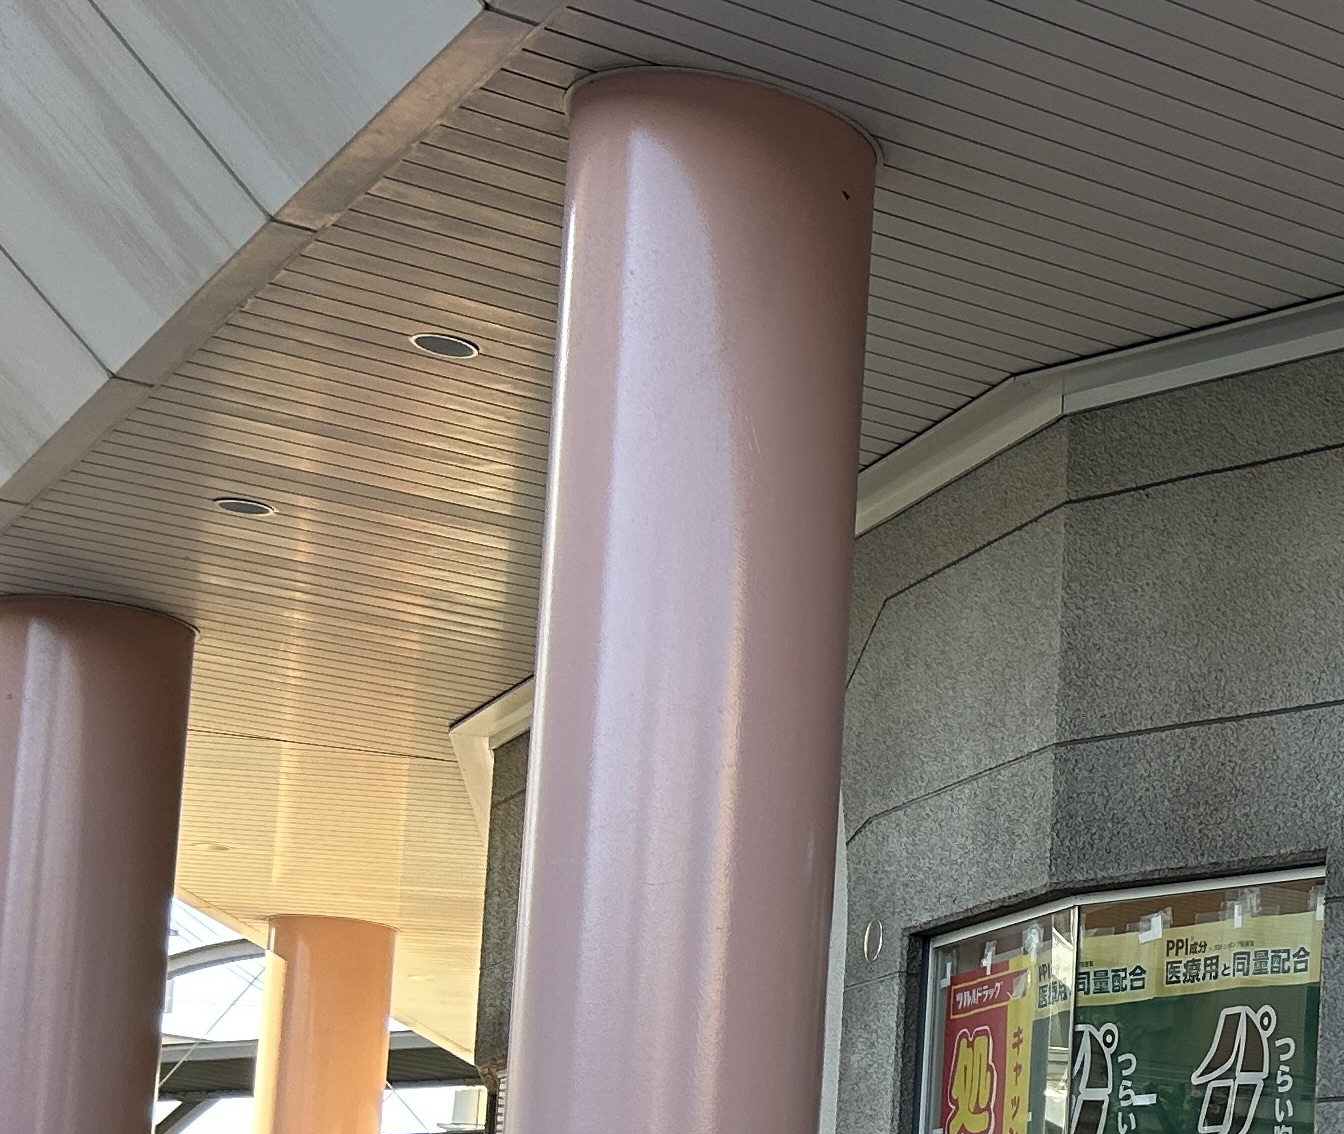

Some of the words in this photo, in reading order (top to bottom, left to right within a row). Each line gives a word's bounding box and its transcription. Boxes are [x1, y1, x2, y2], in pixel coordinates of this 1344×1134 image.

[1165, 947, 1312, 986] 医療用と同量配合
